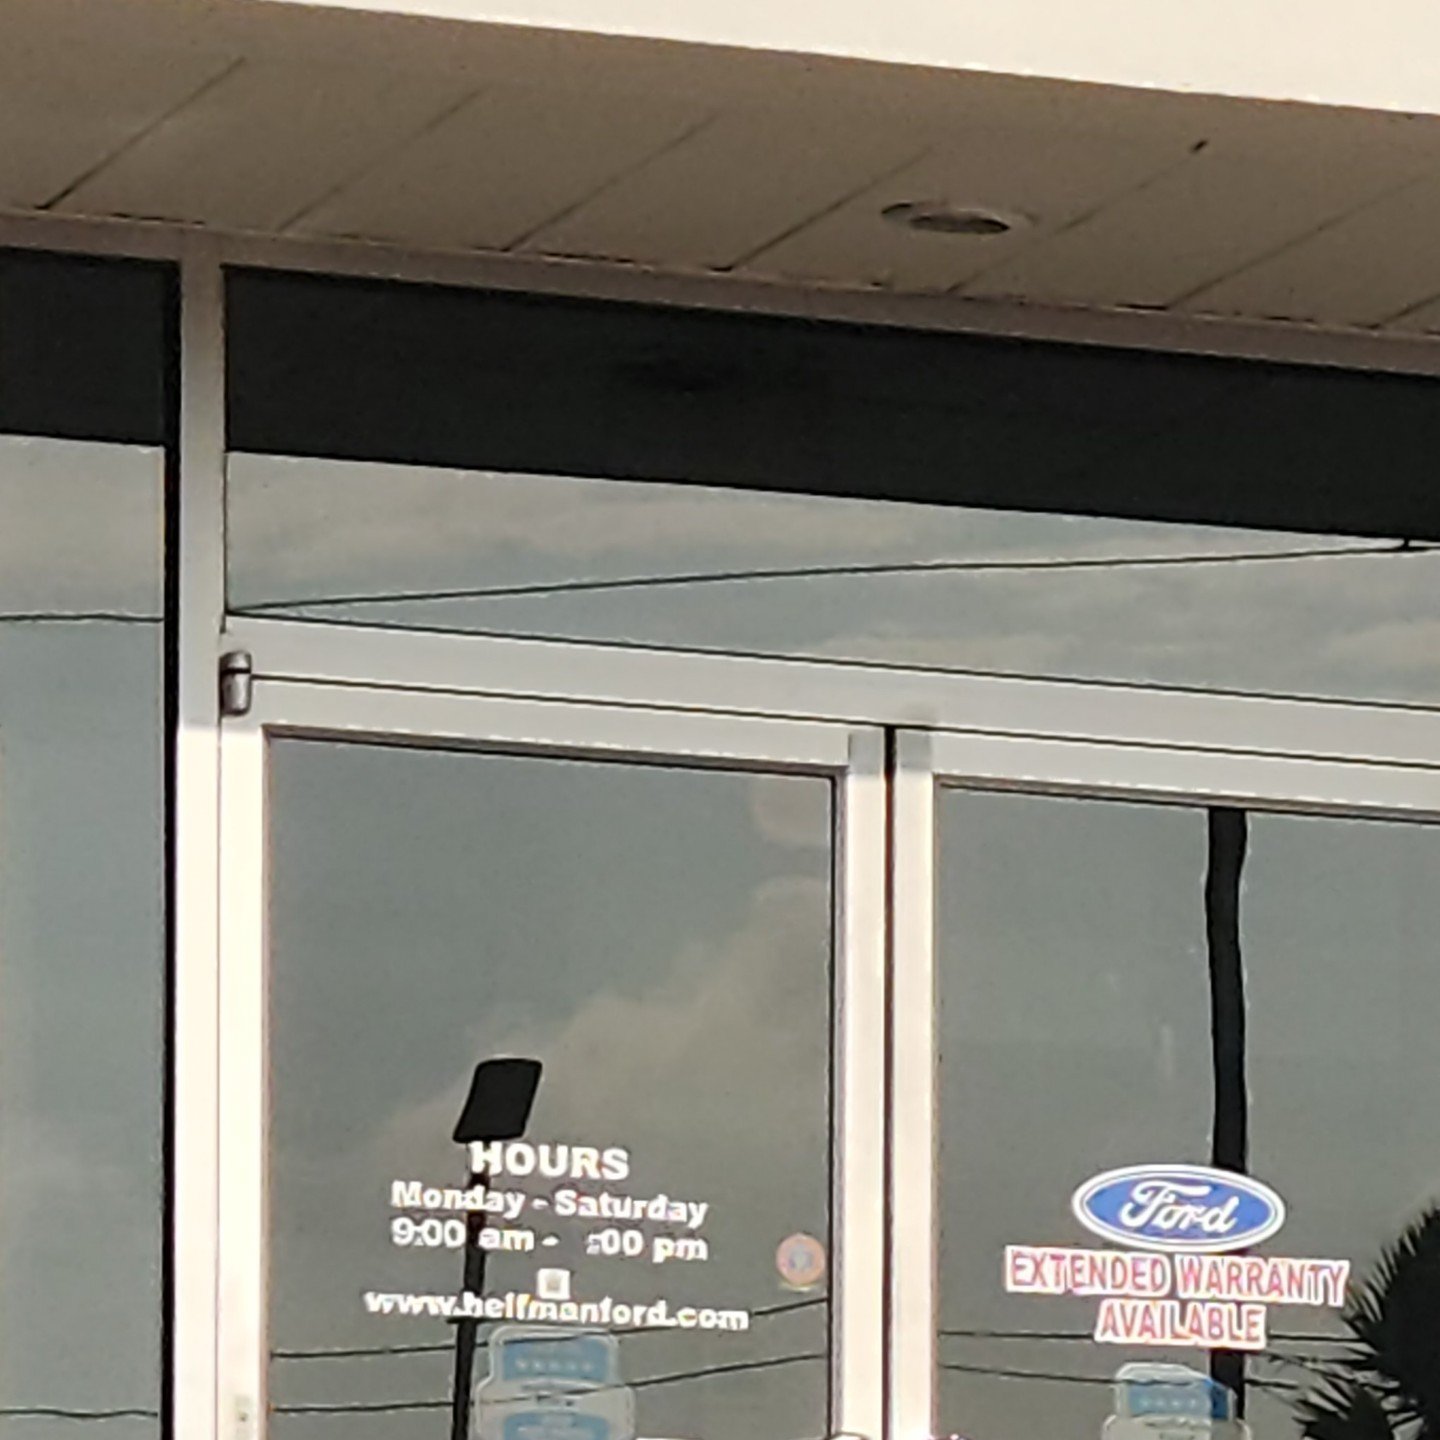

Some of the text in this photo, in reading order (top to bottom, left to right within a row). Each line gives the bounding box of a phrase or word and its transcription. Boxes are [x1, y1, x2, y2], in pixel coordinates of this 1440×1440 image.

[471, 1141, 630, 1181] HOURS
[392, 1181, 524, 1220] Monday
[555, 1189, 708, 1228] Saturday
[1120, 1180, 1239, 1233] Ford
[392, 1218, 466, 1247] 9:00
[478, 1227, 534, 1251] am
[652, 1236, 707, 1263] pm
[1007, 1248, 1348, 1305] EXTENDED WARRANTY
[364, 1291, 750, 1330] www.helfmanford.com
[1097, 1300, 1266, 1348] AVAILABLE
